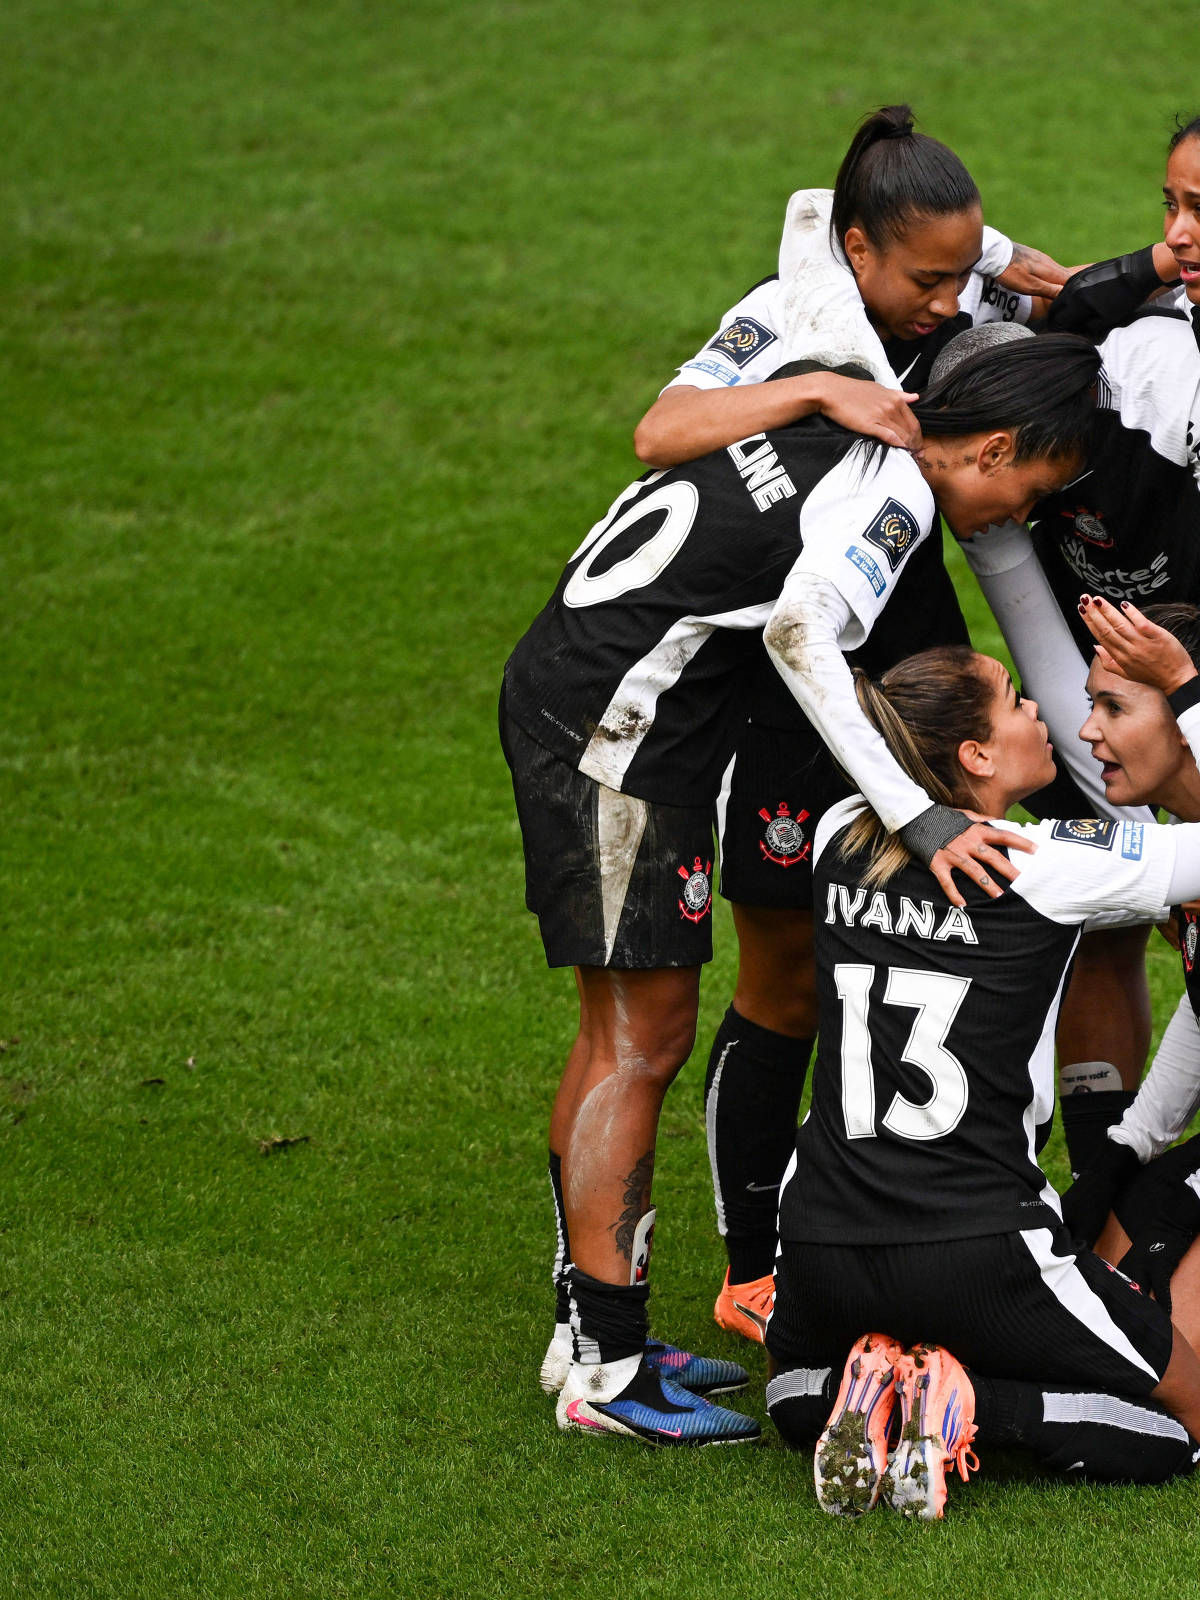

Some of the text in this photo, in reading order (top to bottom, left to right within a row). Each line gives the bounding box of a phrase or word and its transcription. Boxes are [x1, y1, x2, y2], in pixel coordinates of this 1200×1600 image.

[563, 468, 699, 609] 0
[824, 882, 979, 945] IVANA
[833, 962, 974, 1141] 13
